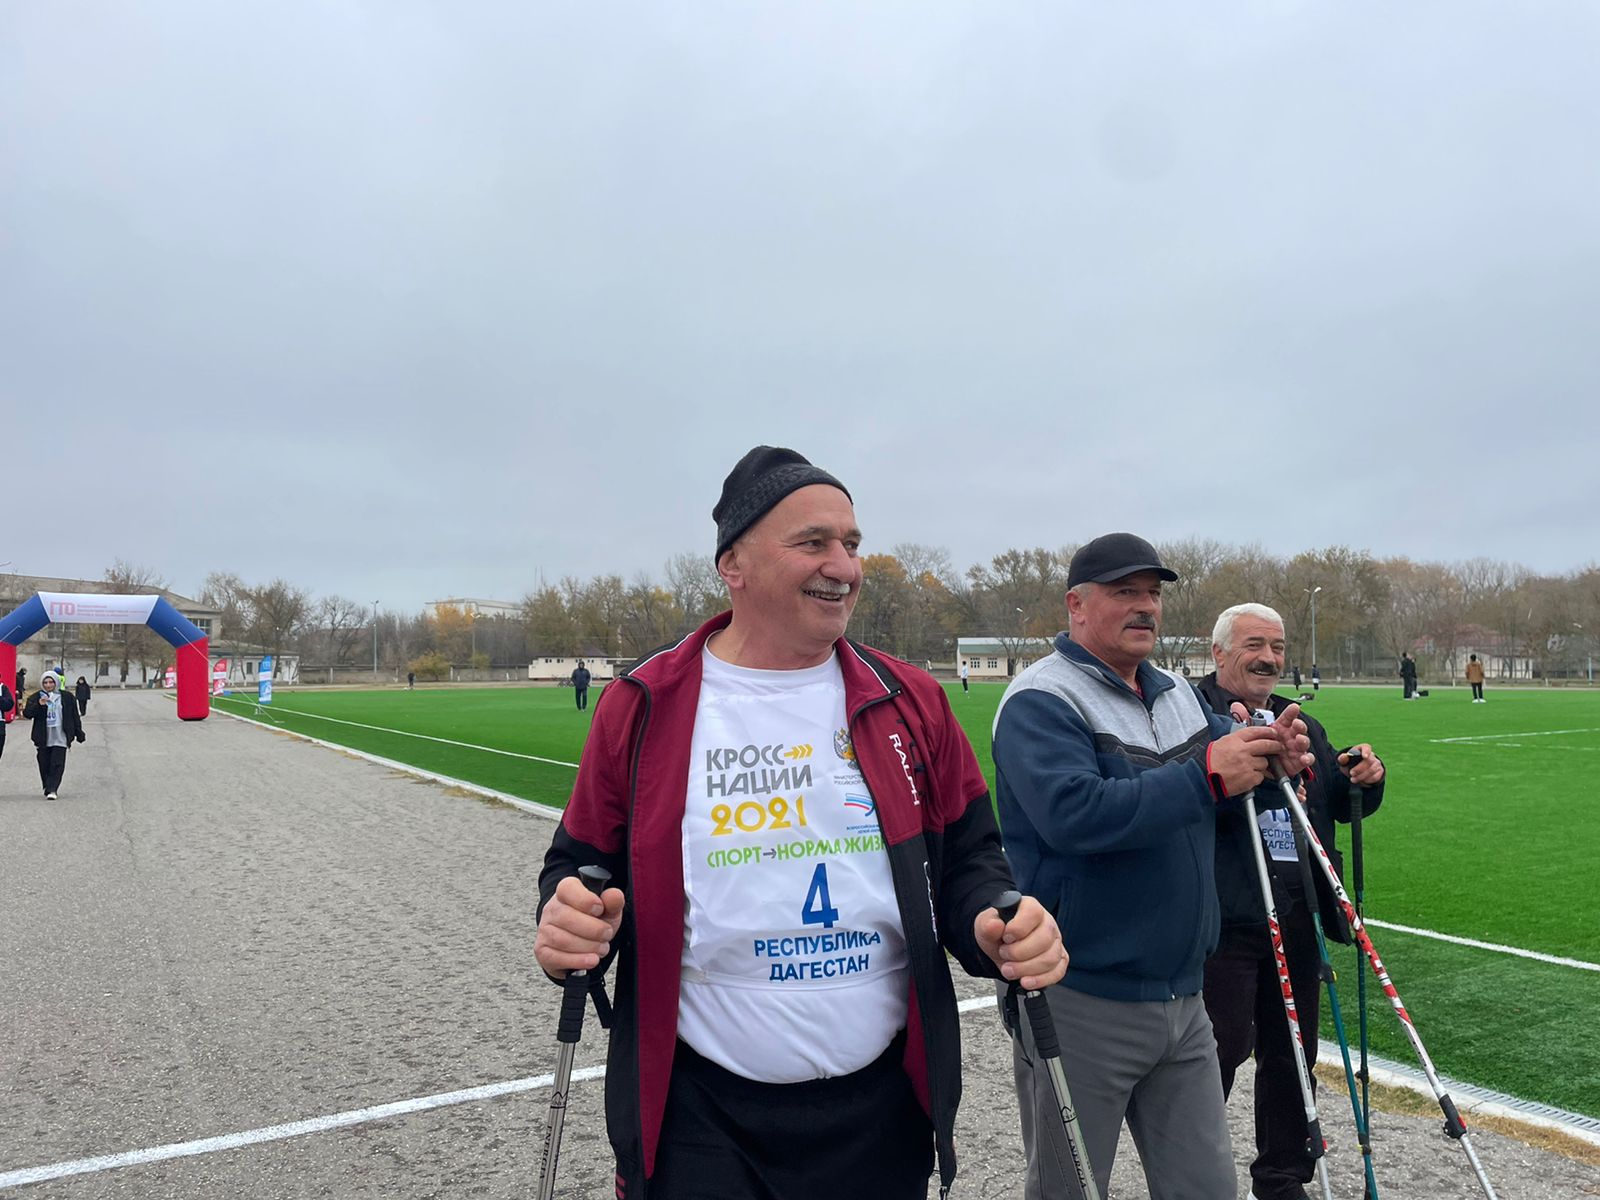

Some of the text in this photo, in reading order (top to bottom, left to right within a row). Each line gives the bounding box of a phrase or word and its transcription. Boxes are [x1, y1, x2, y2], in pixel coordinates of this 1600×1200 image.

[706, 744, 785, 772] КРОСС
[706, 764, 813, 797] НАЦИИ
[710, 795, 808, 836] 2021
[706, 846, 762, 868] СПОРТ
[776, 838, 842, 861] НОРМА
[801, 862, 840, 929] 4
[754, 931, 881, 957] РЕСПУБЛИКА
[769, 954, 870, 982] ДАГЕСТАН
